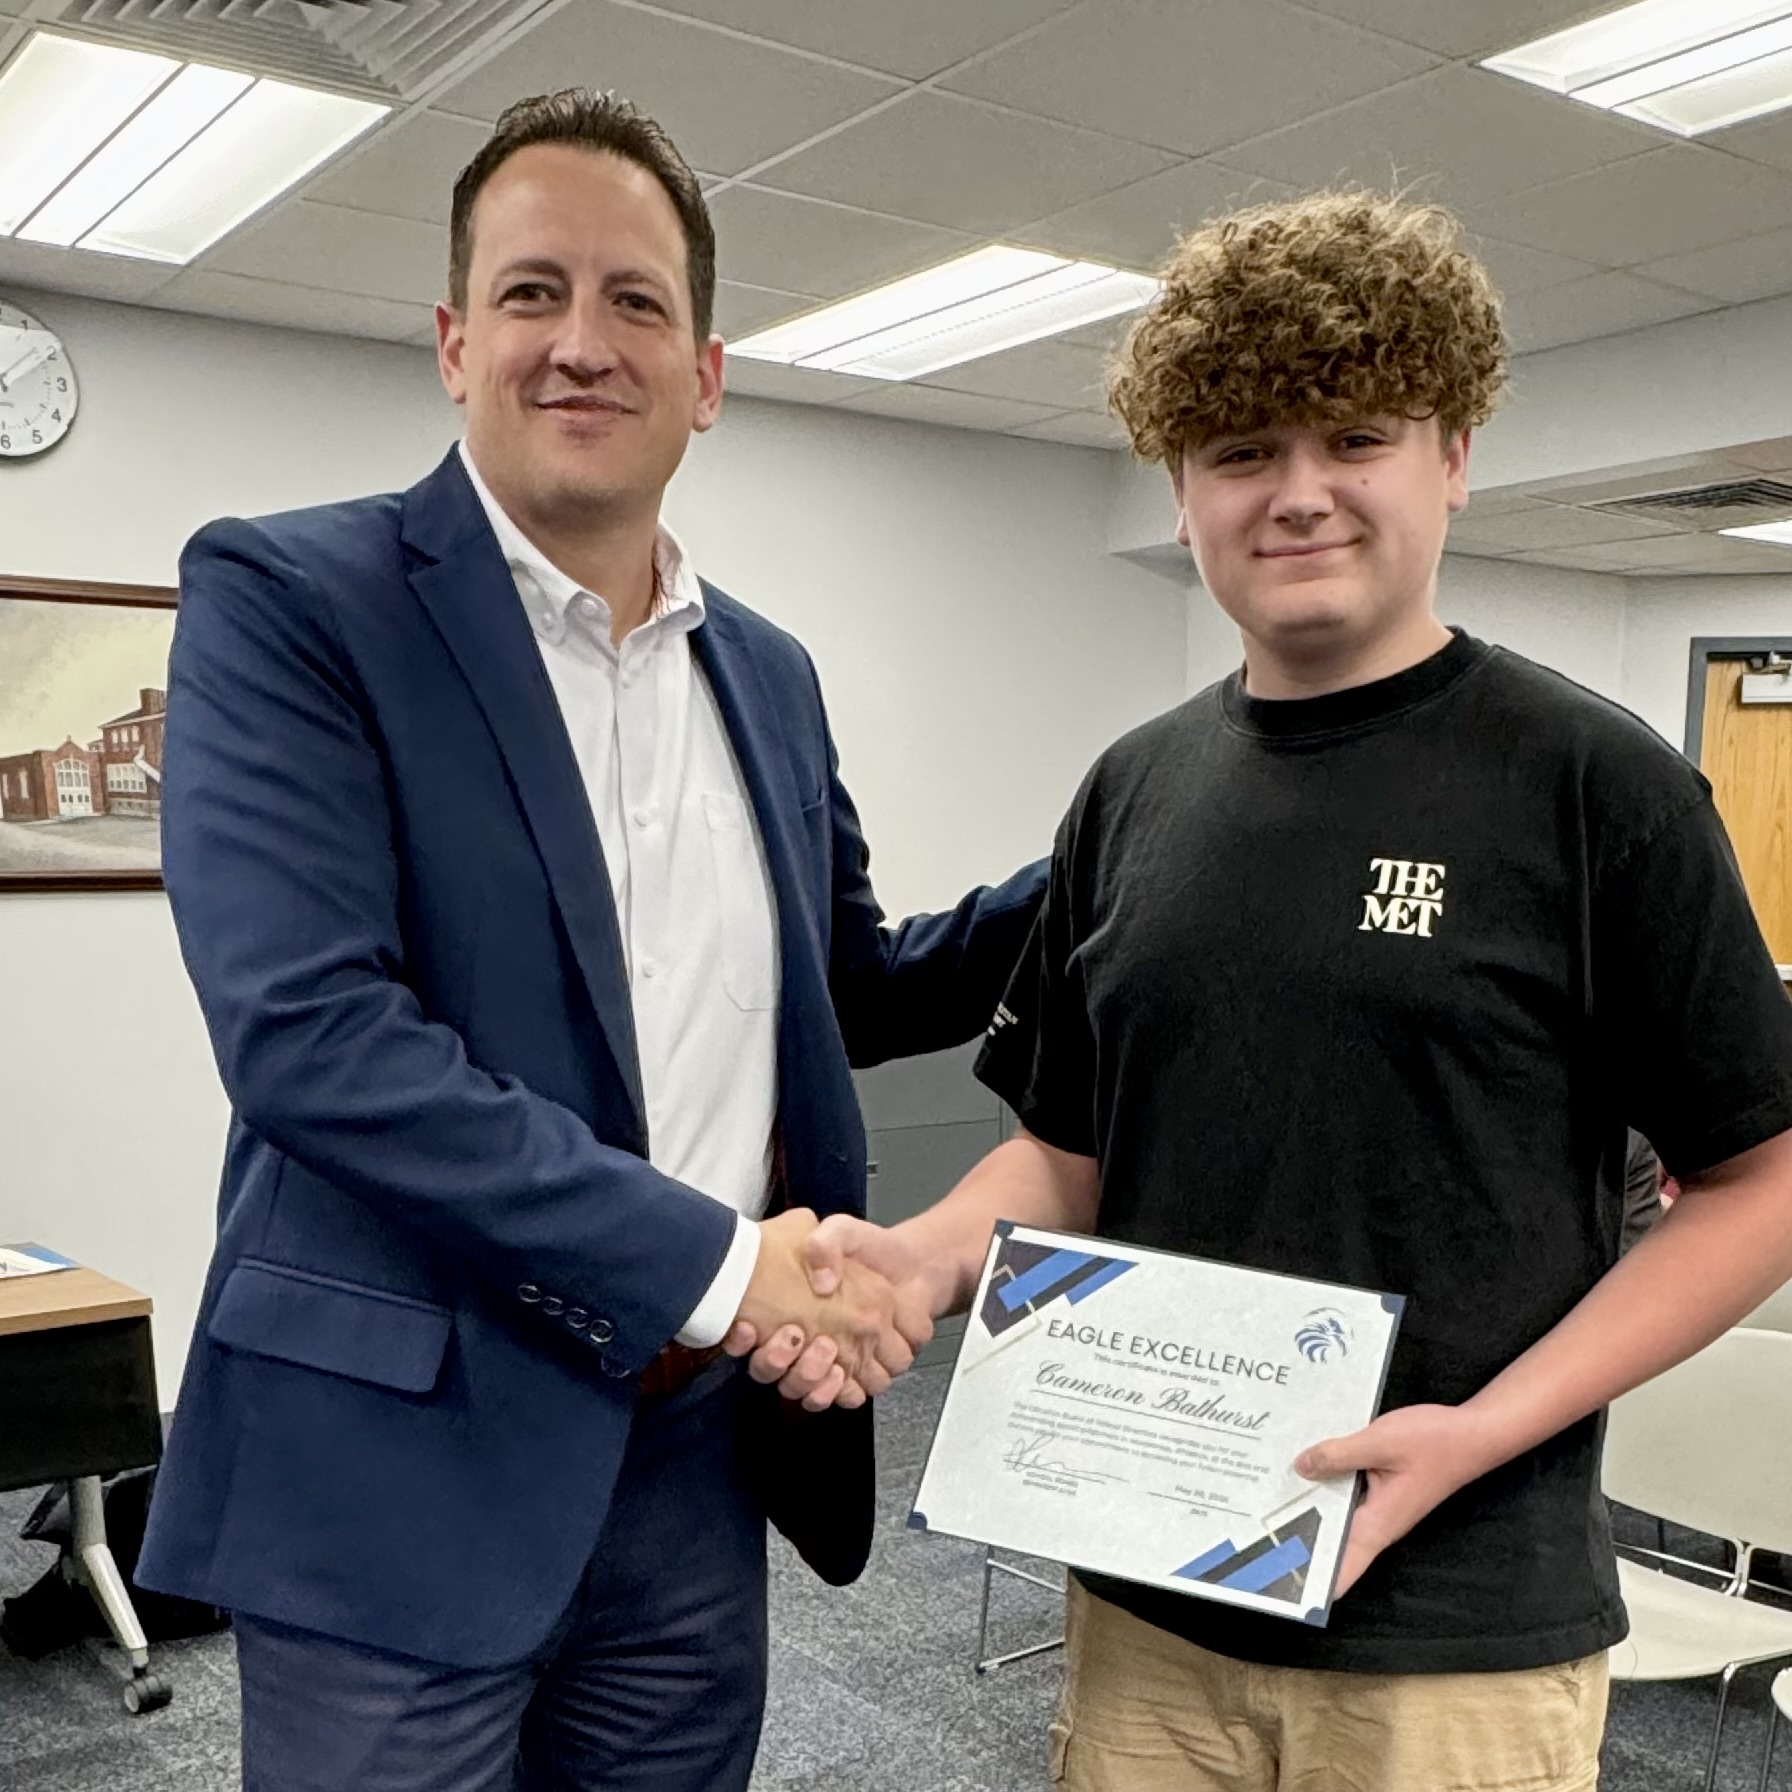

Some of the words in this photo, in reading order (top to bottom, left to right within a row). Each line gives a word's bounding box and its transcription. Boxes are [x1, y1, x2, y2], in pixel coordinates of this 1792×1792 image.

[20, 319, 28, 332] 1
[46, 346, 57, 361] 2
[57, 377, 67, 391] 3
[51, 408, 62, 423] 4
[0, 435, 11, 449] 6
[32, 430, 43, 444] 5
[1369, 857, 1445, 900] THE
[1357, 895, 1443, 937] MET
[1047, 1319, 1124, 1351] EAGLE
[1130, 1336, 1291, 1386] EXCELLENCE
[1035, 1360, 1146, 1406] Cameron
[1151, 1387, 1272, 1431] Bathurst
